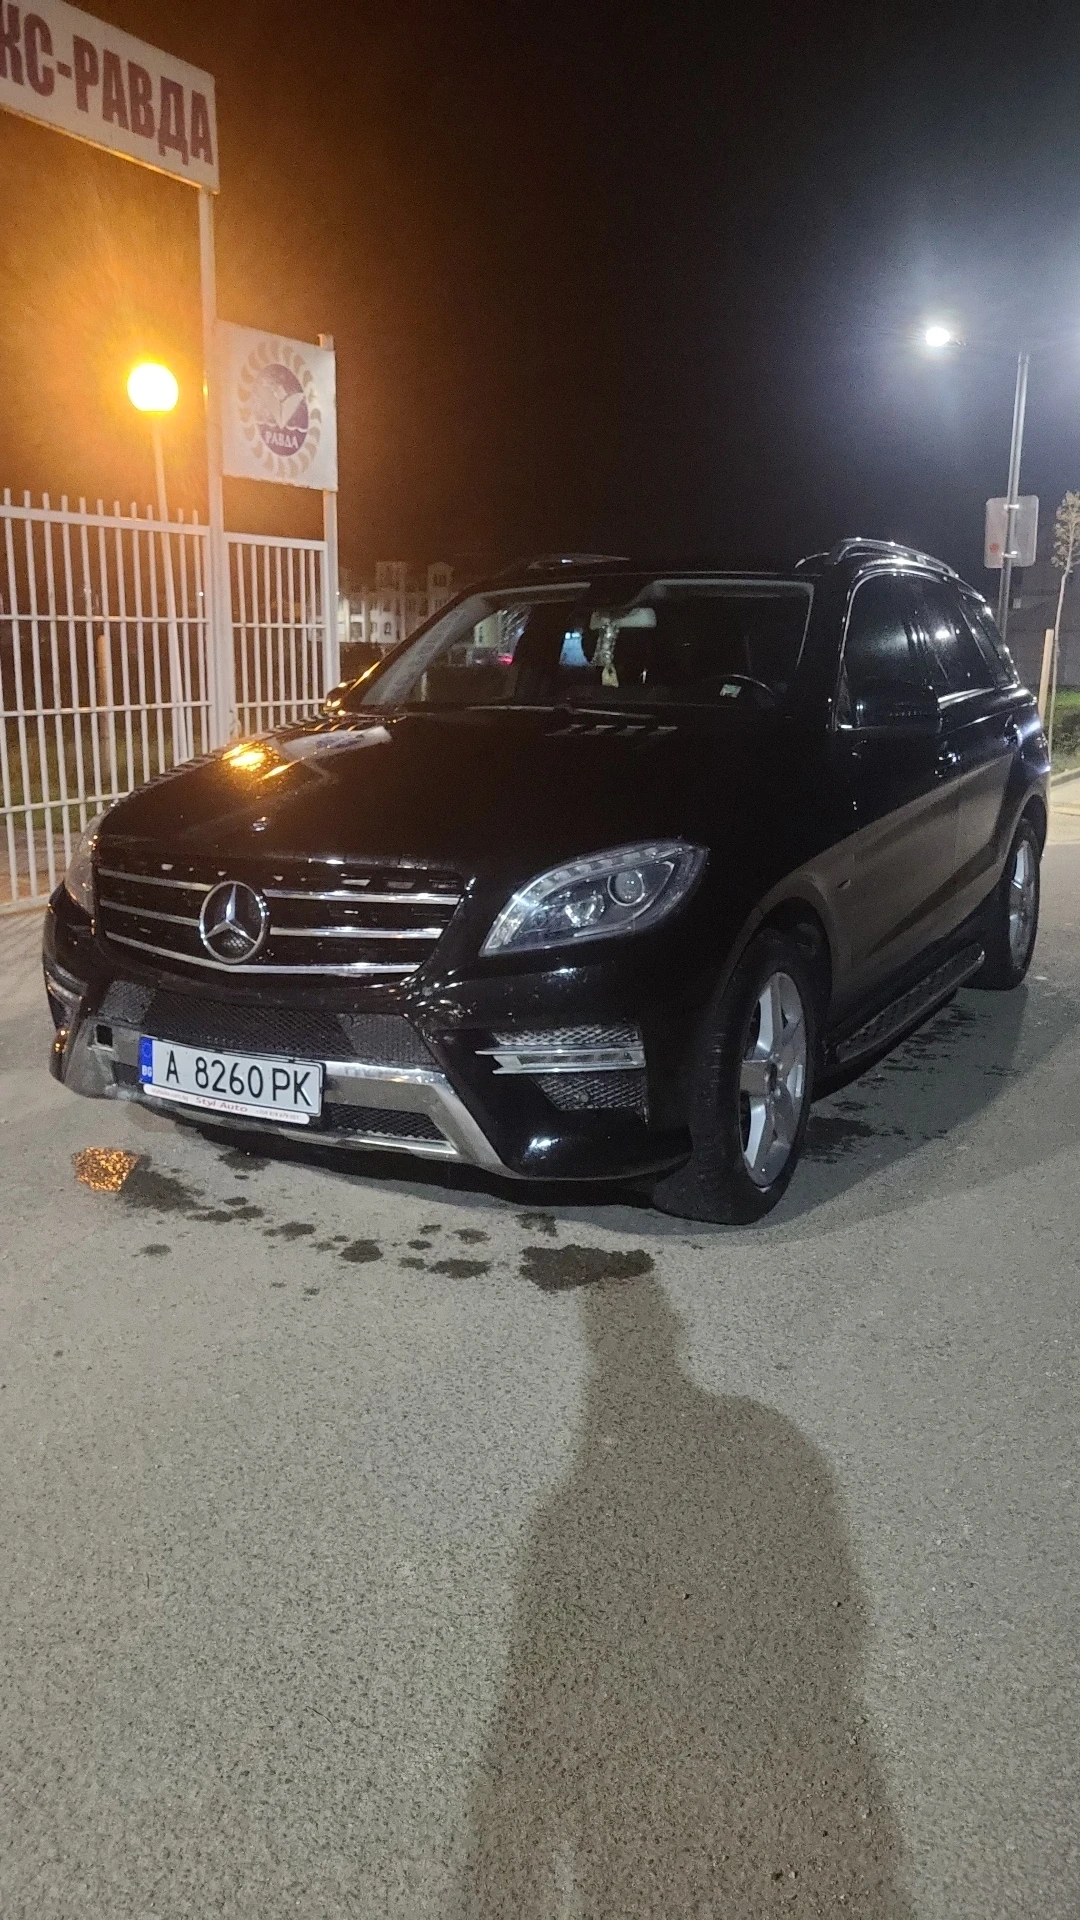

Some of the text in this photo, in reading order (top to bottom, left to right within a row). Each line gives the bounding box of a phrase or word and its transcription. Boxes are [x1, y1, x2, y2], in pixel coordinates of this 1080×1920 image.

[141, 1064, 153, 1077] BG
[165, 1050, 313, 1106] A 8260 PK
[196, 1096, 248, 1112] Styl Auto
